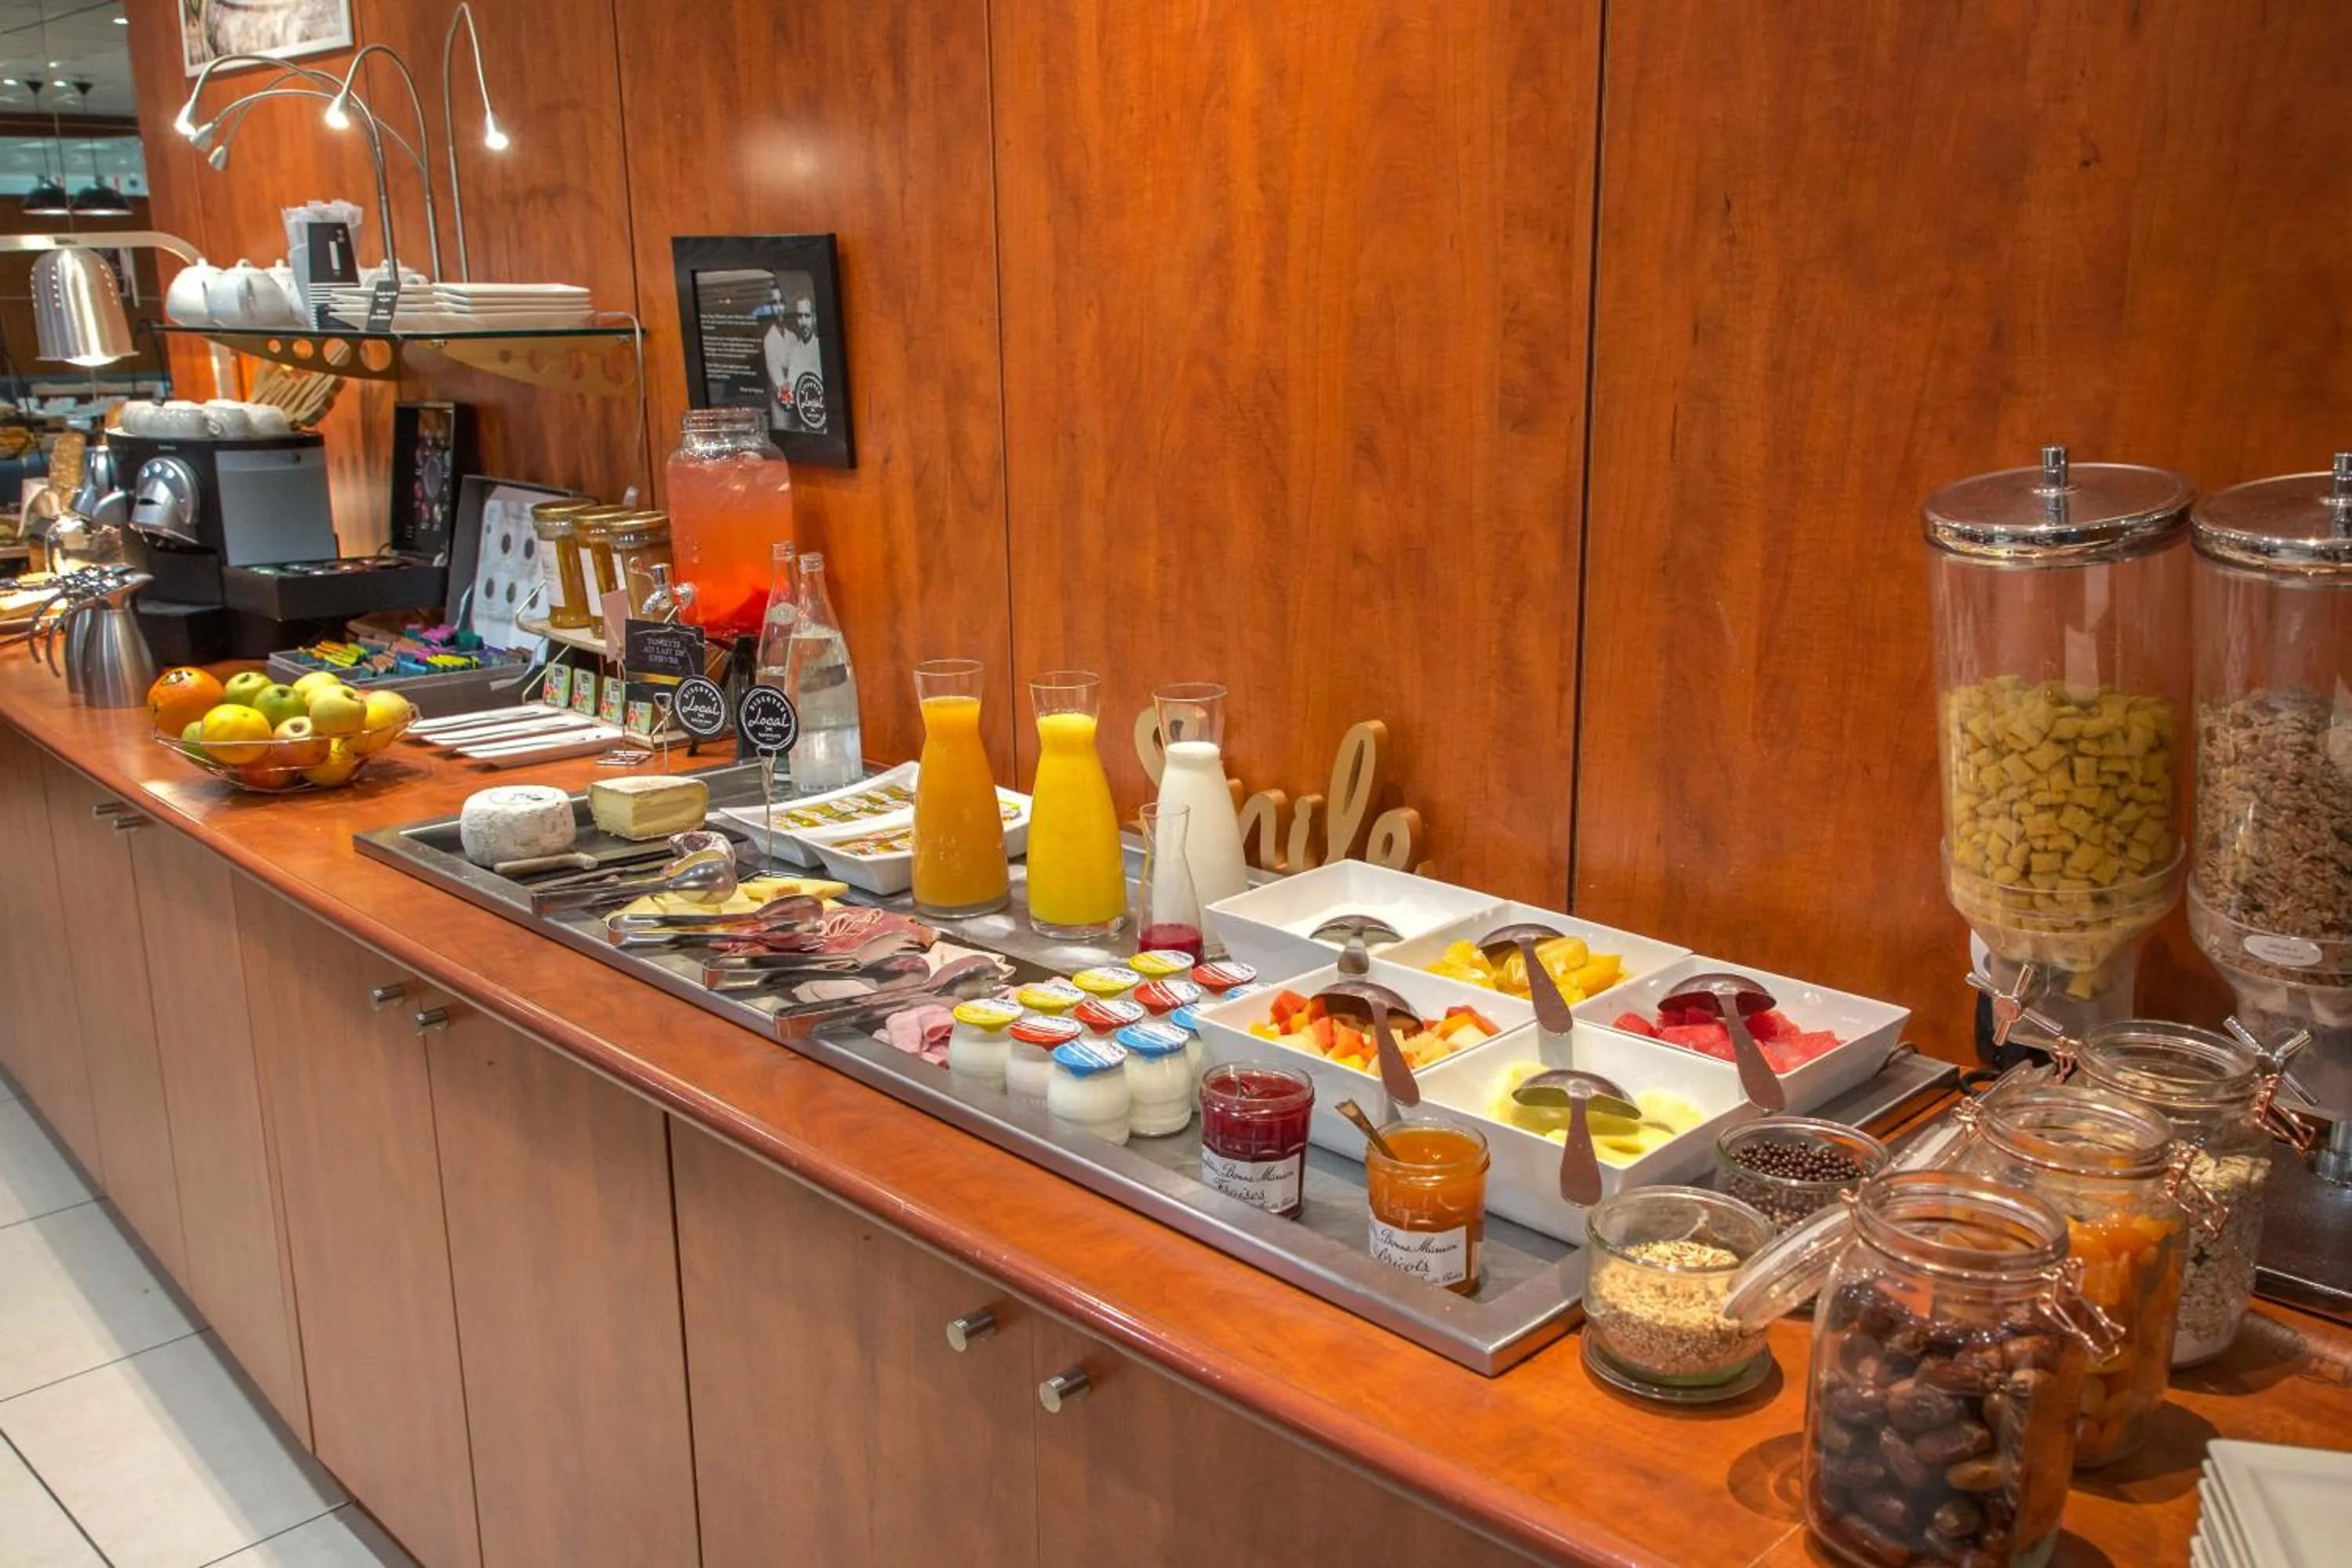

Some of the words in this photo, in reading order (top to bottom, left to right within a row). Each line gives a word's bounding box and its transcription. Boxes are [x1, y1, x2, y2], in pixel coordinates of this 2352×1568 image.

[681, 695, 720, 715] Local
[748, 706, 789, 728] Local
[1220, 1163, 1255, 1183] Bonne
[1377, 1229, 1412, 1253] Bonne
